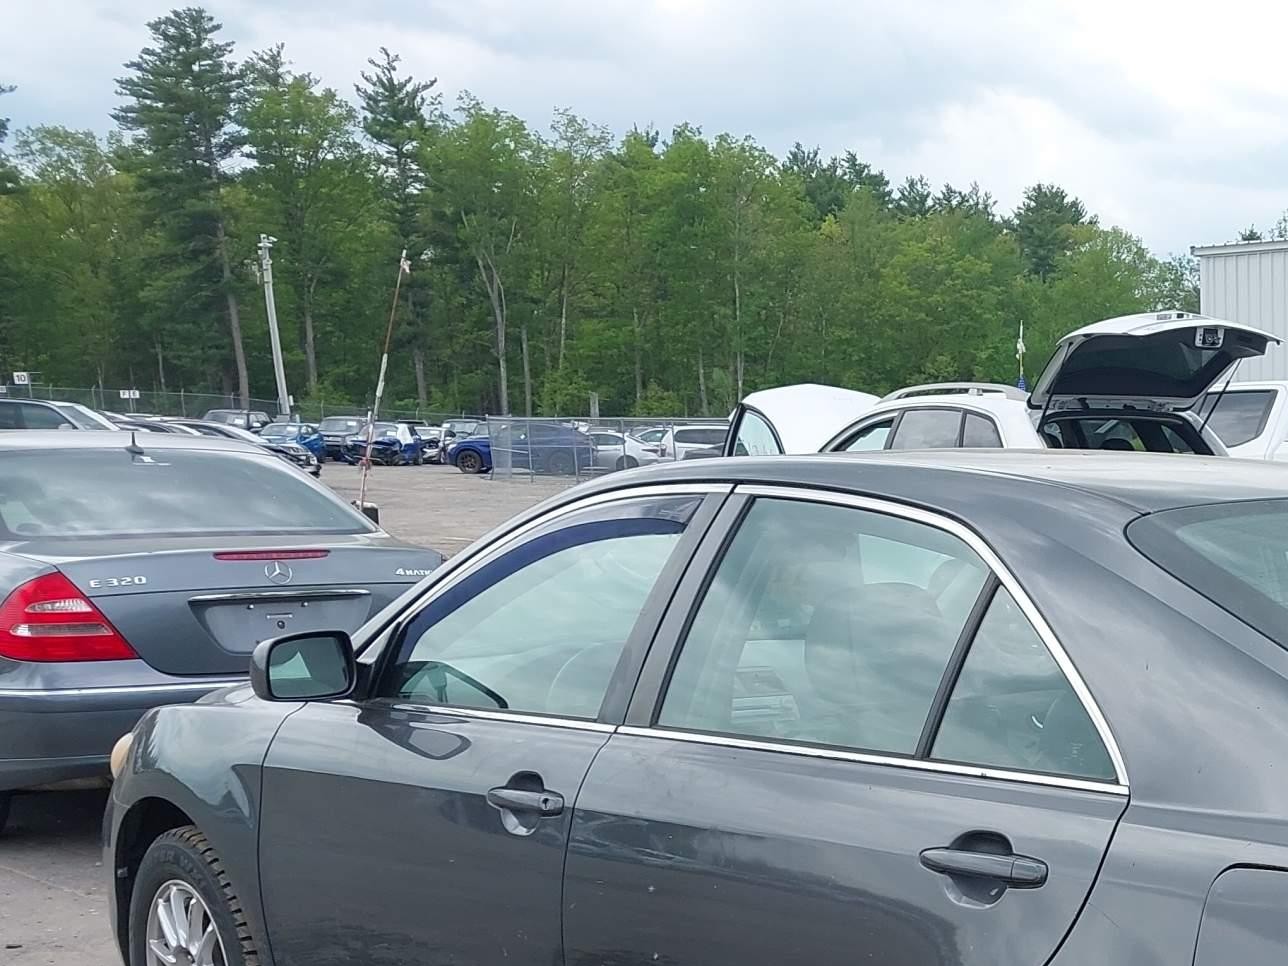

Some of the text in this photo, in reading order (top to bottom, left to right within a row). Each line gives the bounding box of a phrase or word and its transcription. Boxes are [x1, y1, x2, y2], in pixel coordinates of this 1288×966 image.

[16, 374, 26, 383] 10
[89, 575, 147, 588] E 320
